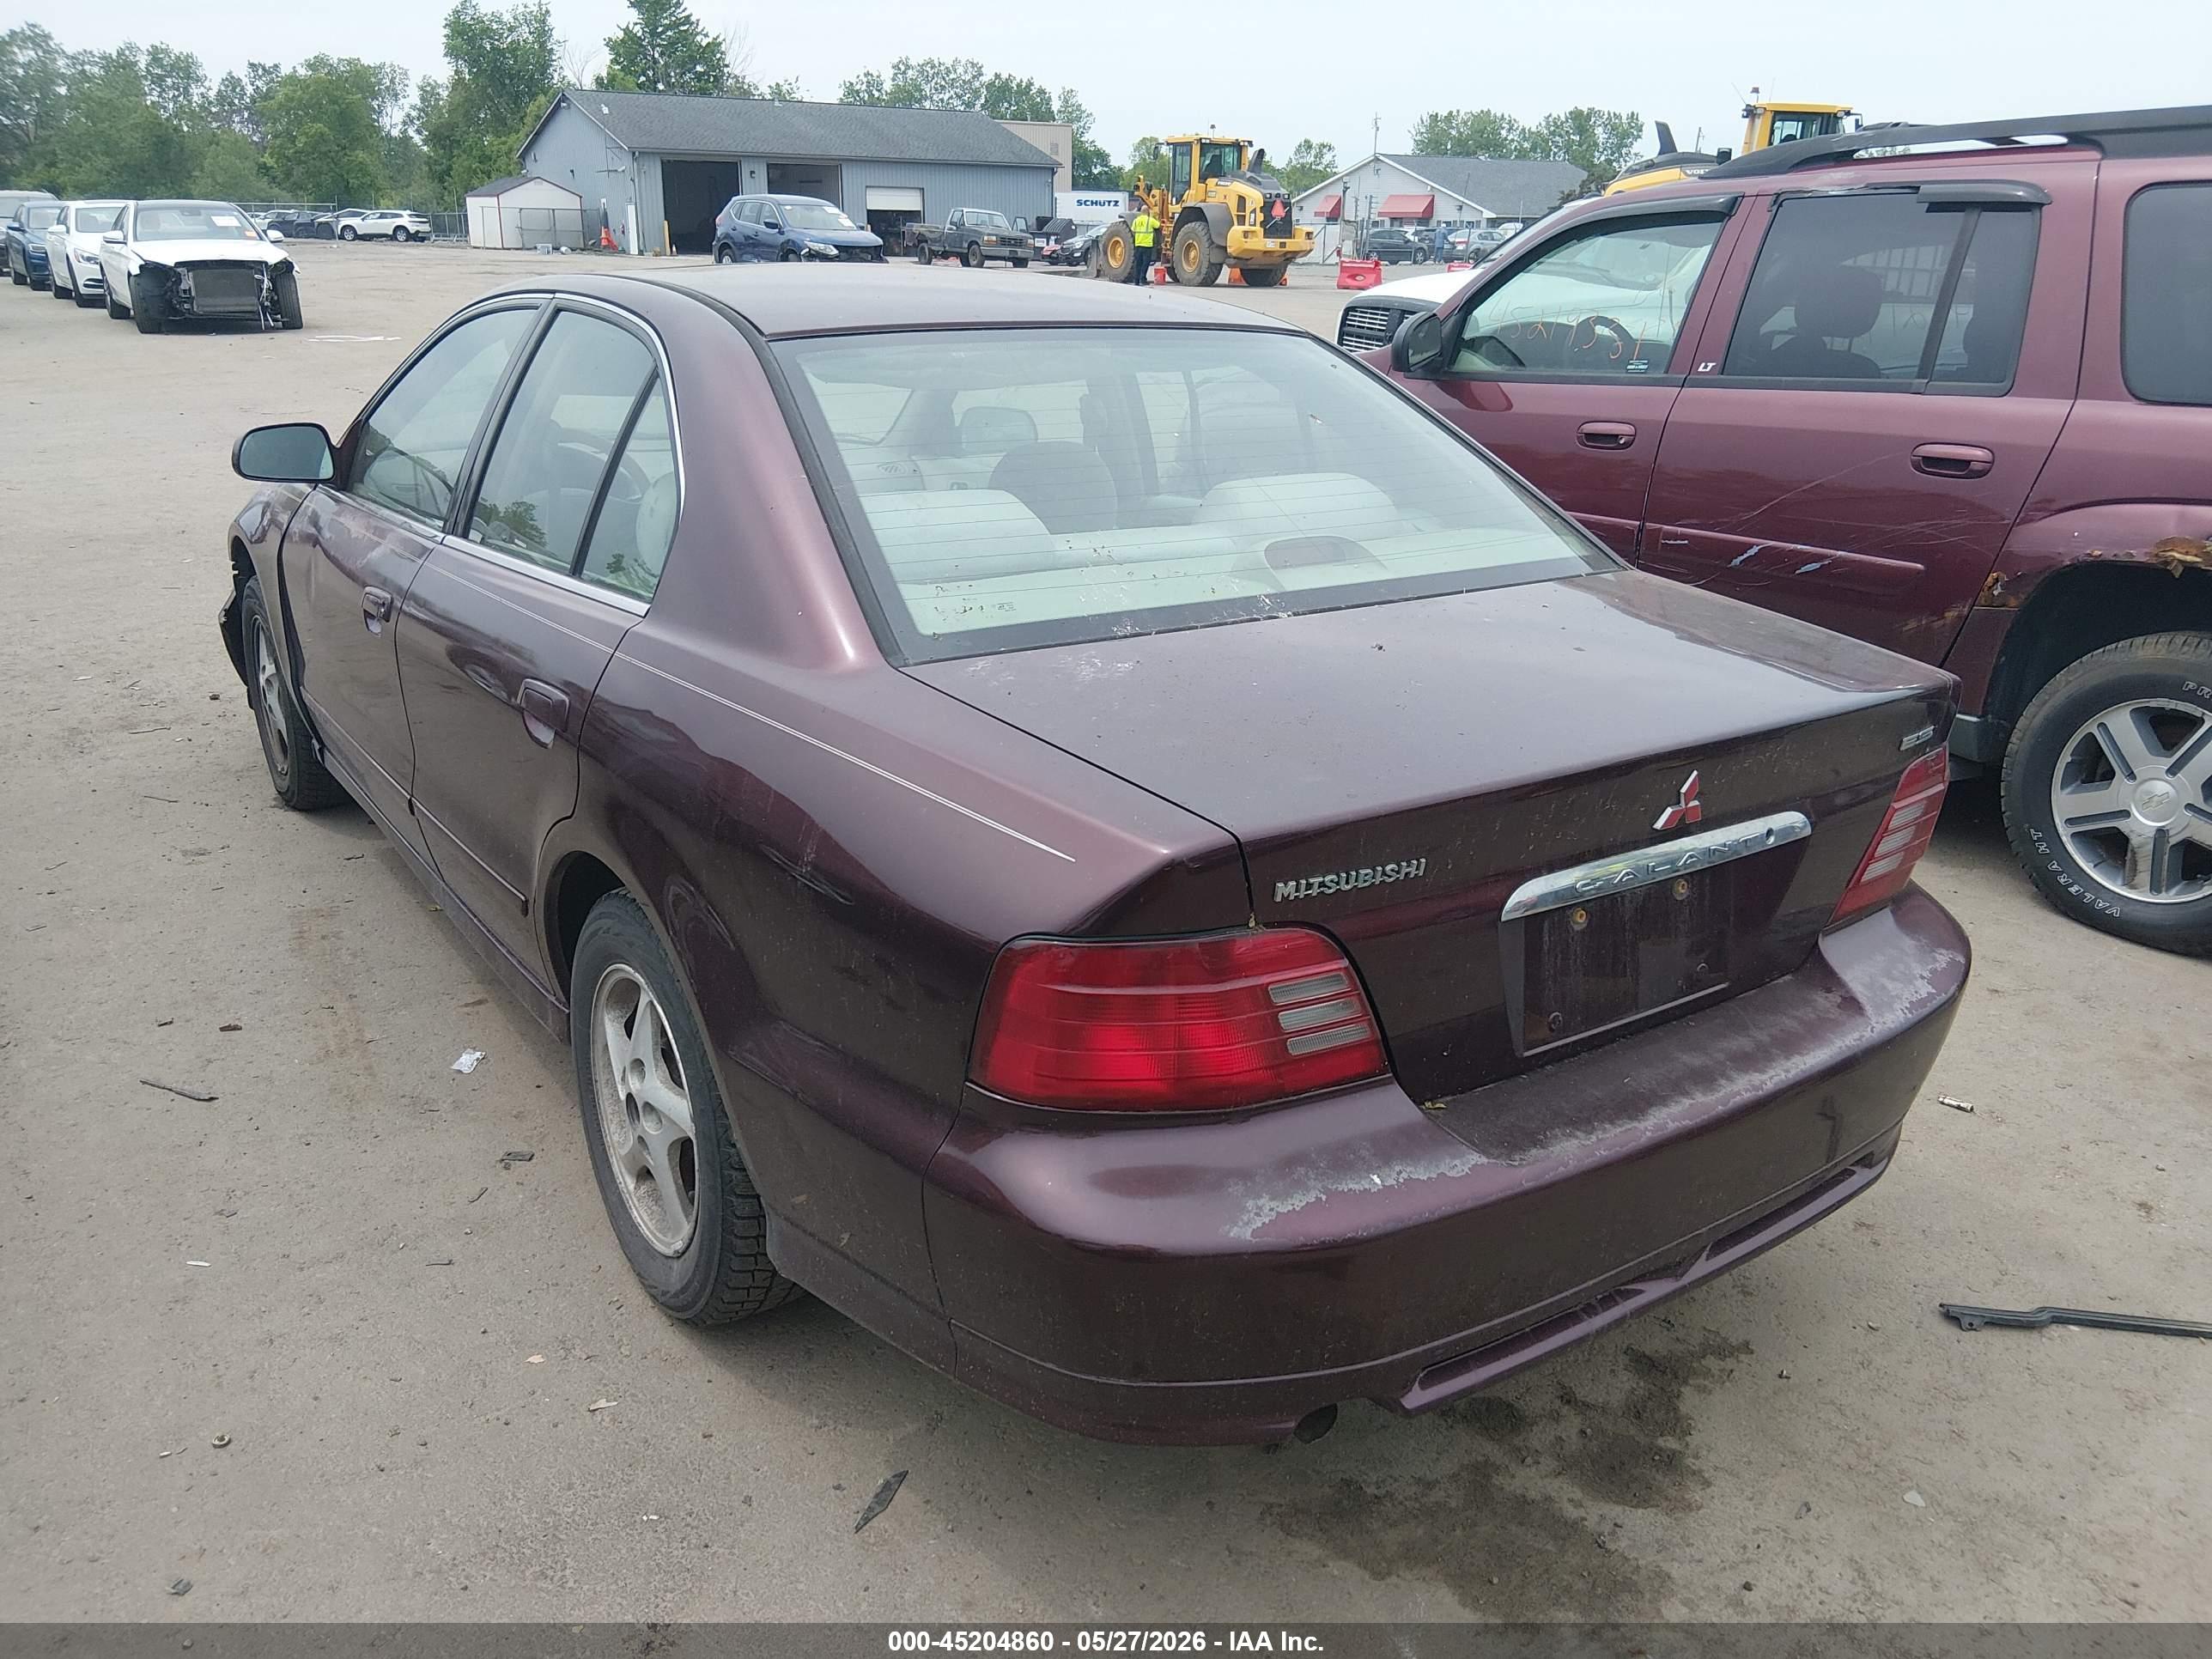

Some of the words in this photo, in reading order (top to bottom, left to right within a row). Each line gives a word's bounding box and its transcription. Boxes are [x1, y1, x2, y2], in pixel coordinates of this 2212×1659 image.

[1698, 362, 1717, 372] LT
[2182, 681, 2212, 699] PR
[1899, 726, 1935, 751] ES
[2029, 828, 2051, 854] HT
[1576, 832, 1760, 893] GALANT
[1273, 858, 1426, 902] MITSUBISHI
[2047, 860, 2121, 917] VALERA
